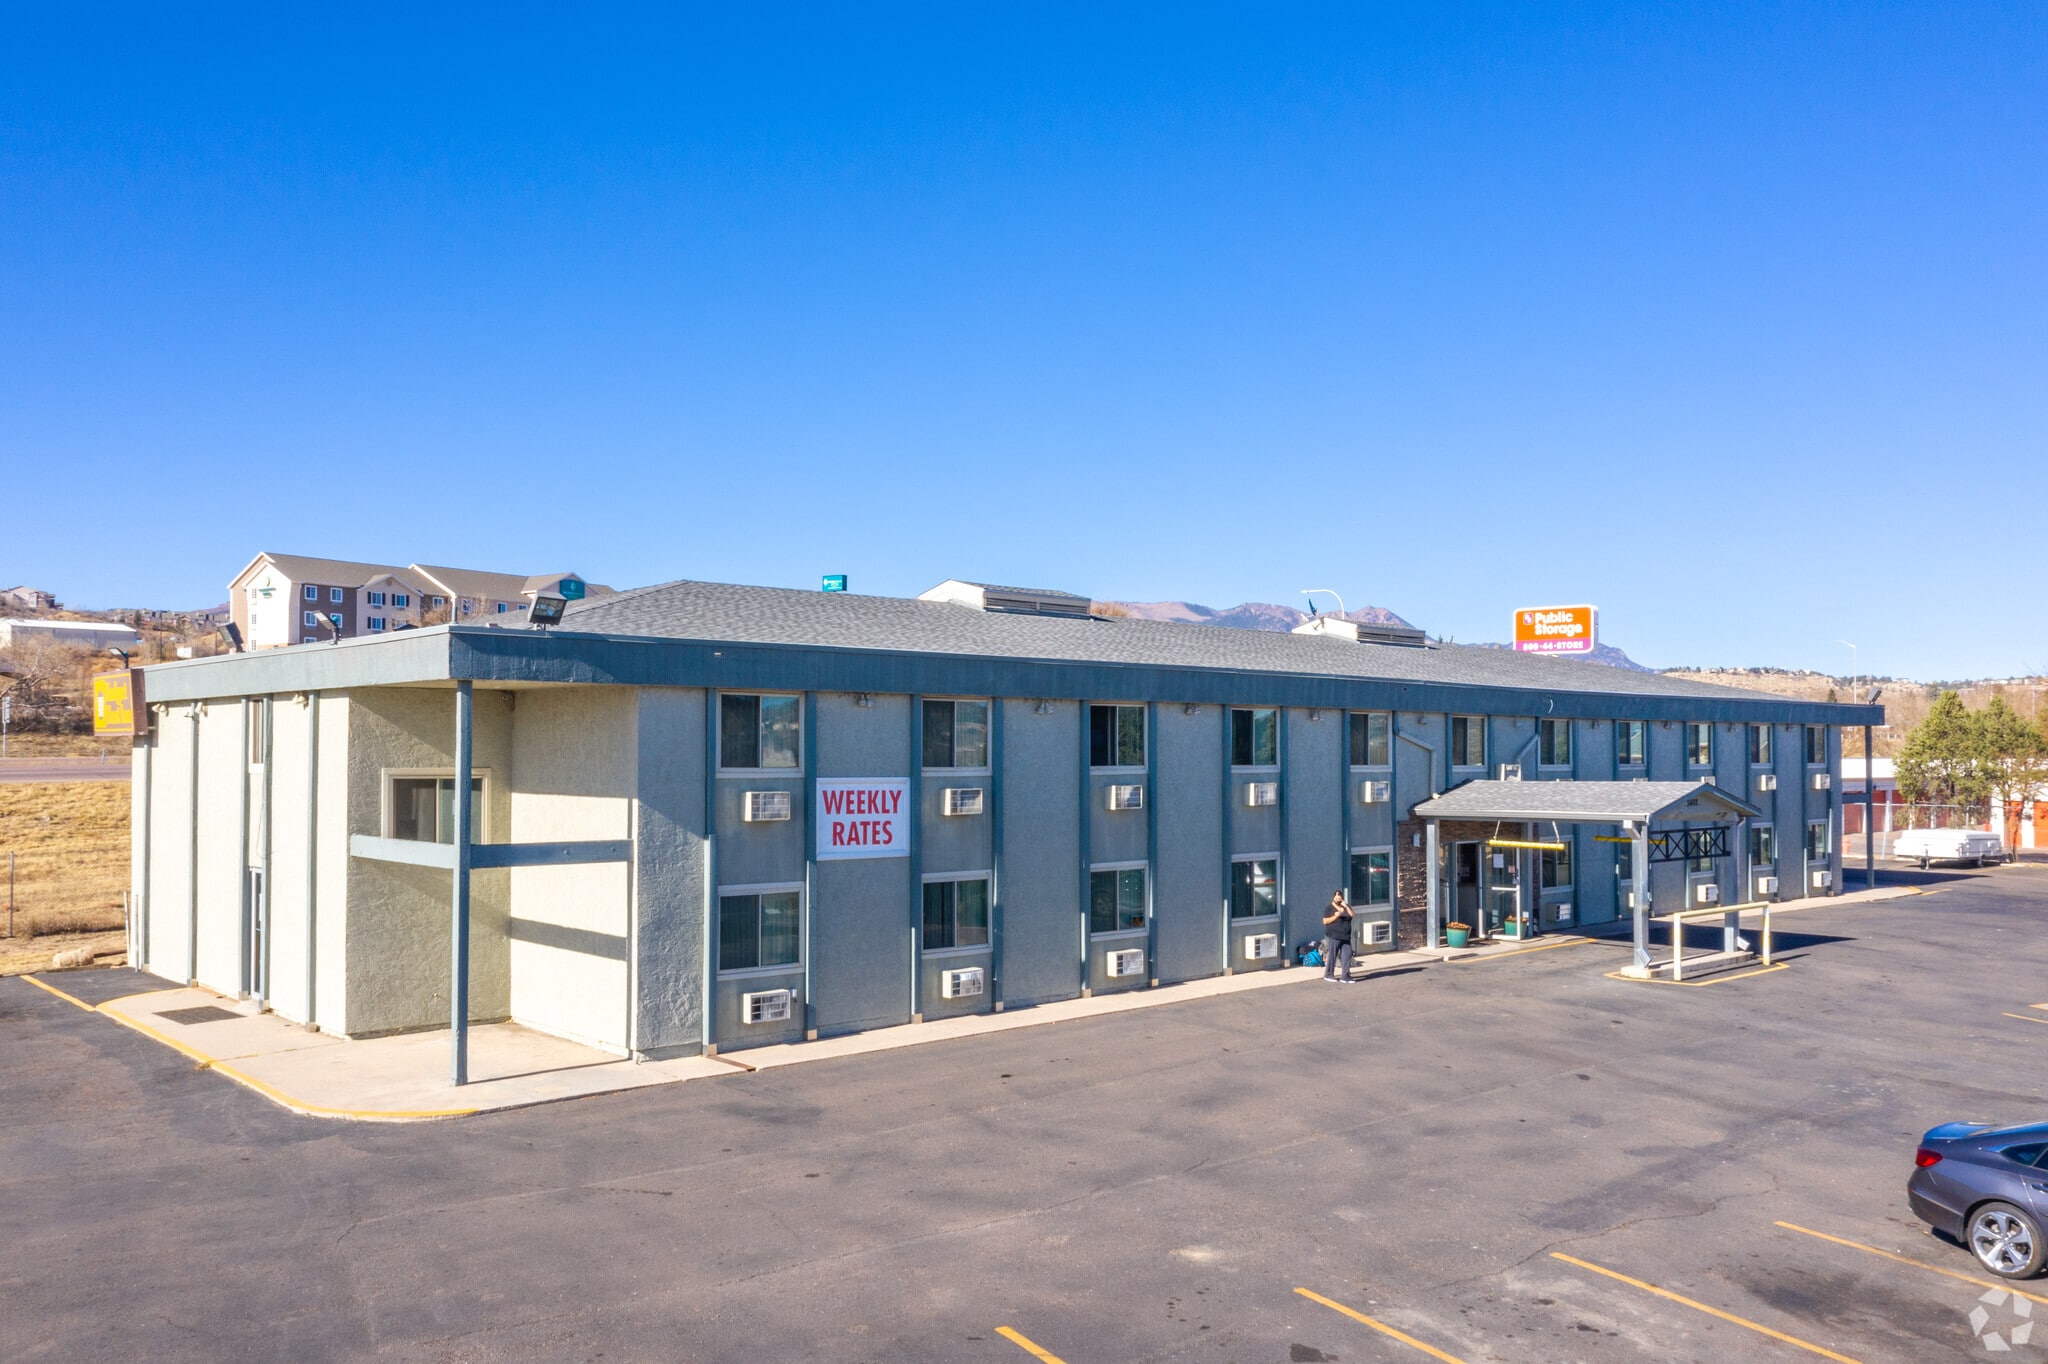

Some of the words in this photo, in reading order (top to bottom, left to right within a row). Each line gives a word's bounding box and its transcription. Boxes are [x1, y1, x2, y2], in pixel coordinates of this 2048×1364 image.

[1535, 611, 1573, 624] Public
[1535, 624, 1583, 637] Storage
[822, 790, 902, 815] WEEKLY
[832, 820, 893, 846] RATES
